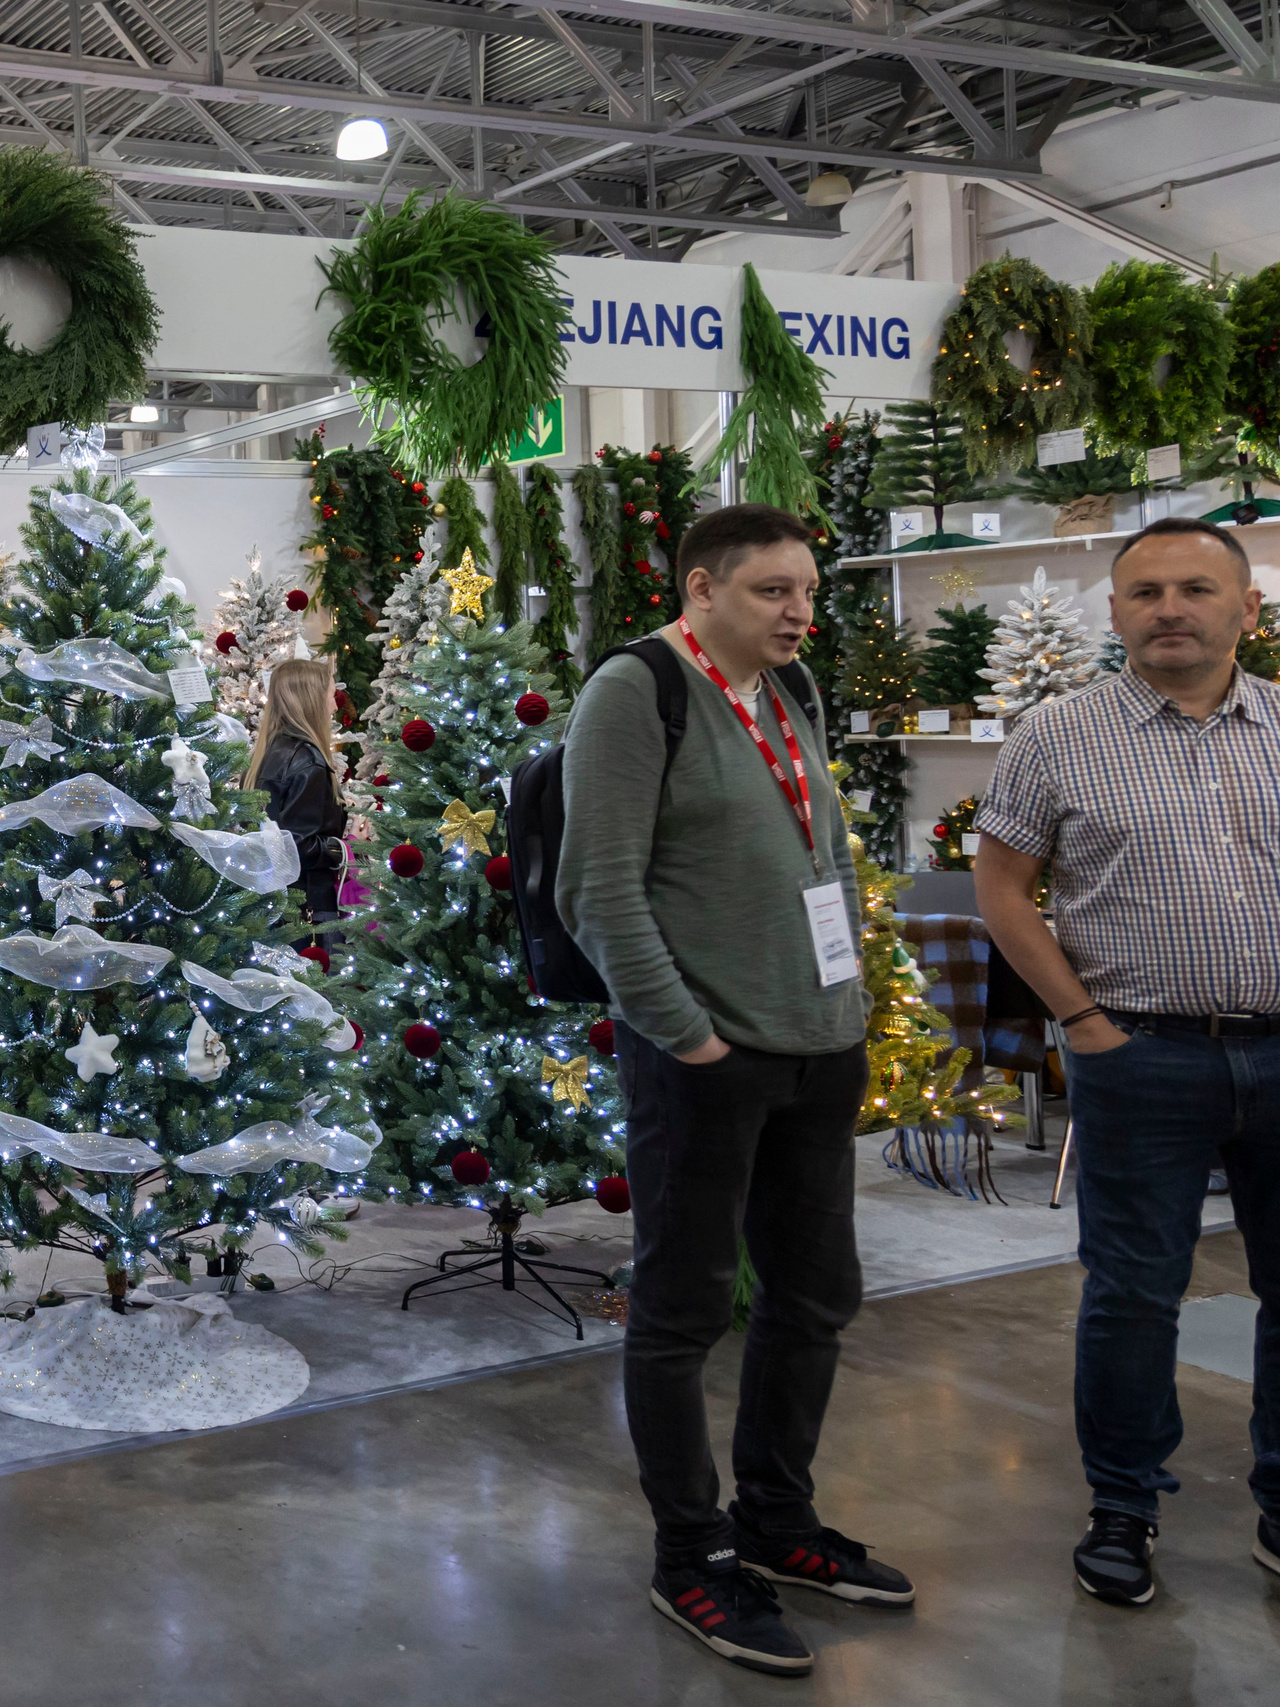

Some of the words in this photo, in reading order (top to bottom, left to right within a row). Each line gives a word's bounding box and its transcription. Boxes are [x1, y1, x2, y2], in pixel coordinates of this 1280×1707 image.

[475, 297, 723, 350] EJIANG
[778, 311, 910, 360] EXING
[707, 1548, 735, 1562] adidas
